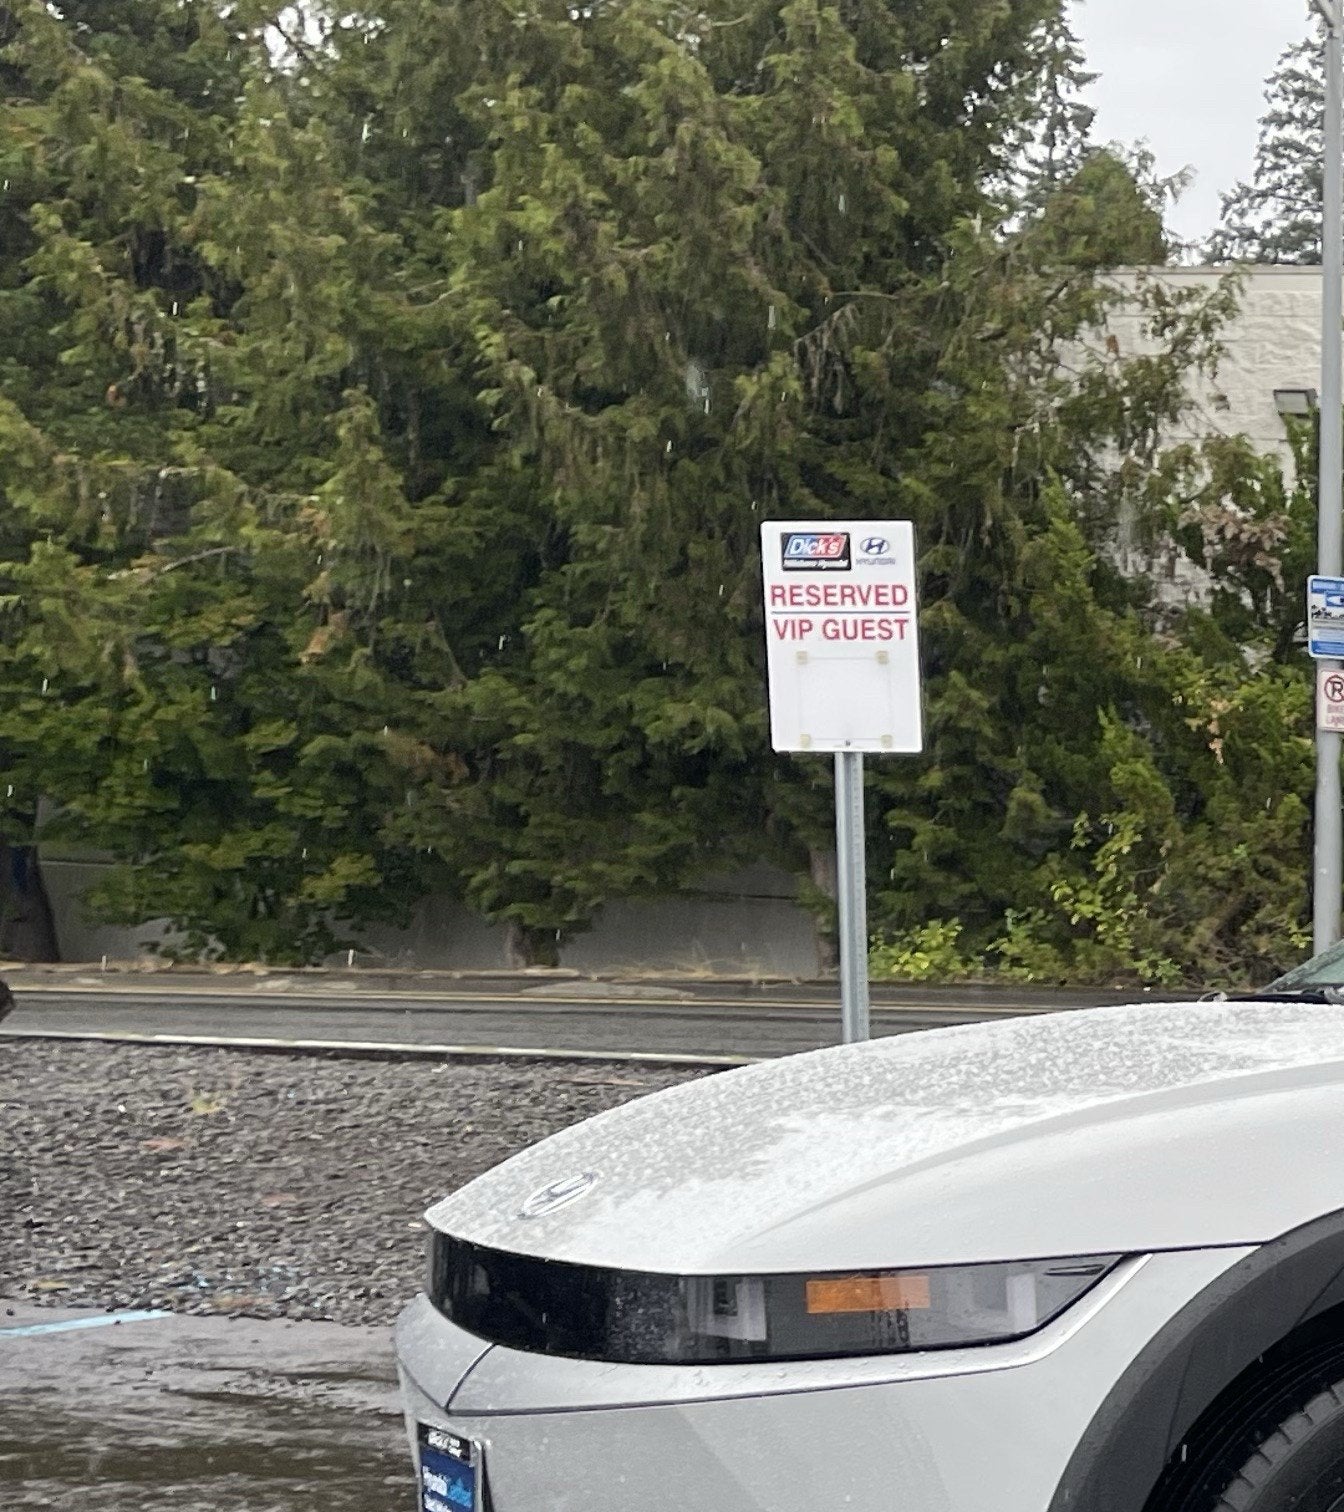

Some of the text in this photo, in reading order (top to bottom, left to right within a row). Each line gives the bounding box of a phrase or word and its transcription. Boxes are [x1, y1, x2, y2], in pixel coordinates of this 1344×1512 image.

[770, 584, 908, 607] RESERVED
[773, 618, 909, 641] VIP GUEST
